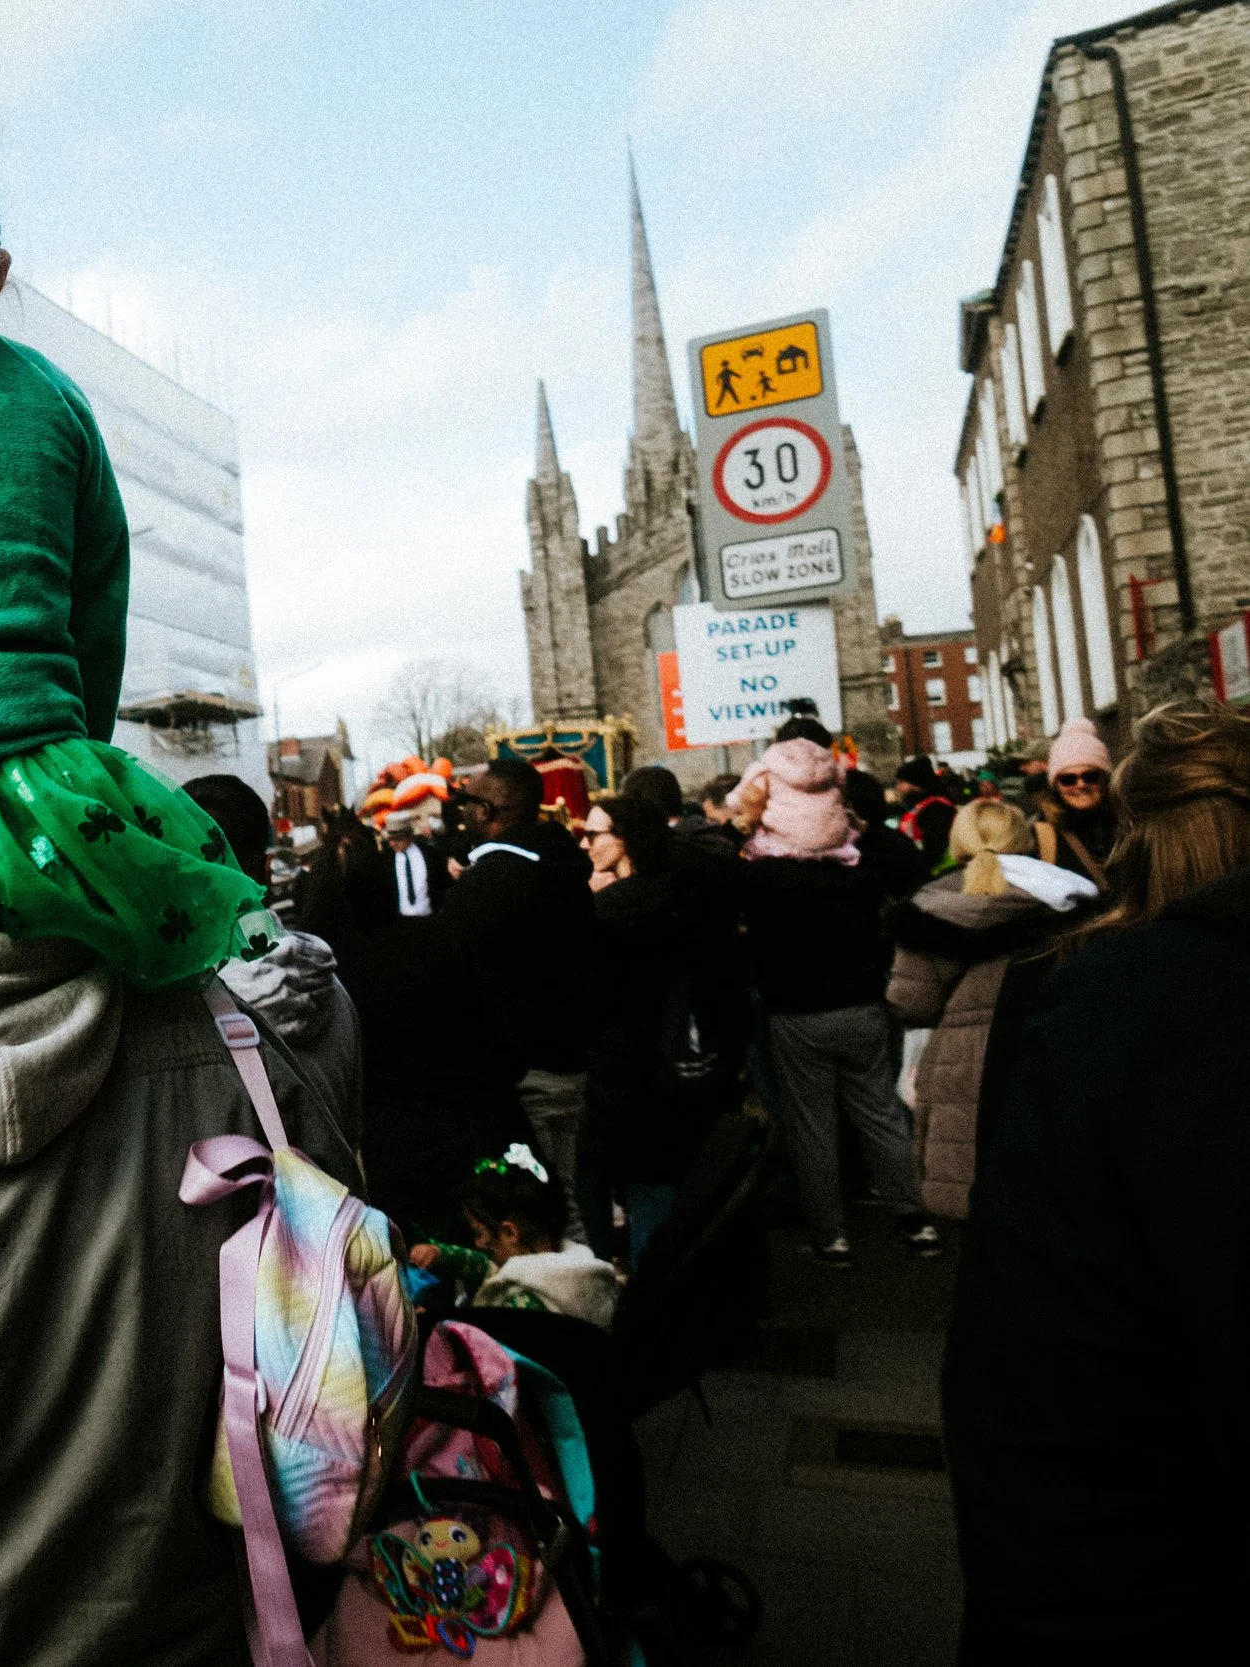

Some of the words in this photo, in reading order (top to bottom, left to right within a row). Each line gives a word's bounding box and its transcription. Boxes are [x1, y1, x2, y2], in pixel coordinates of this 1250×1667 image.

[744, 443, 798, 489] 30
[730, 568, 780, 588] SLOW
[786, 558, 835, 579] ZONE
[707, 612, 798, 638] PARADE
[716, 639, 796, 662] SET-UP
[741, 675, 778, 692] NO
[709, 701, 798, 721] VIEWIN
